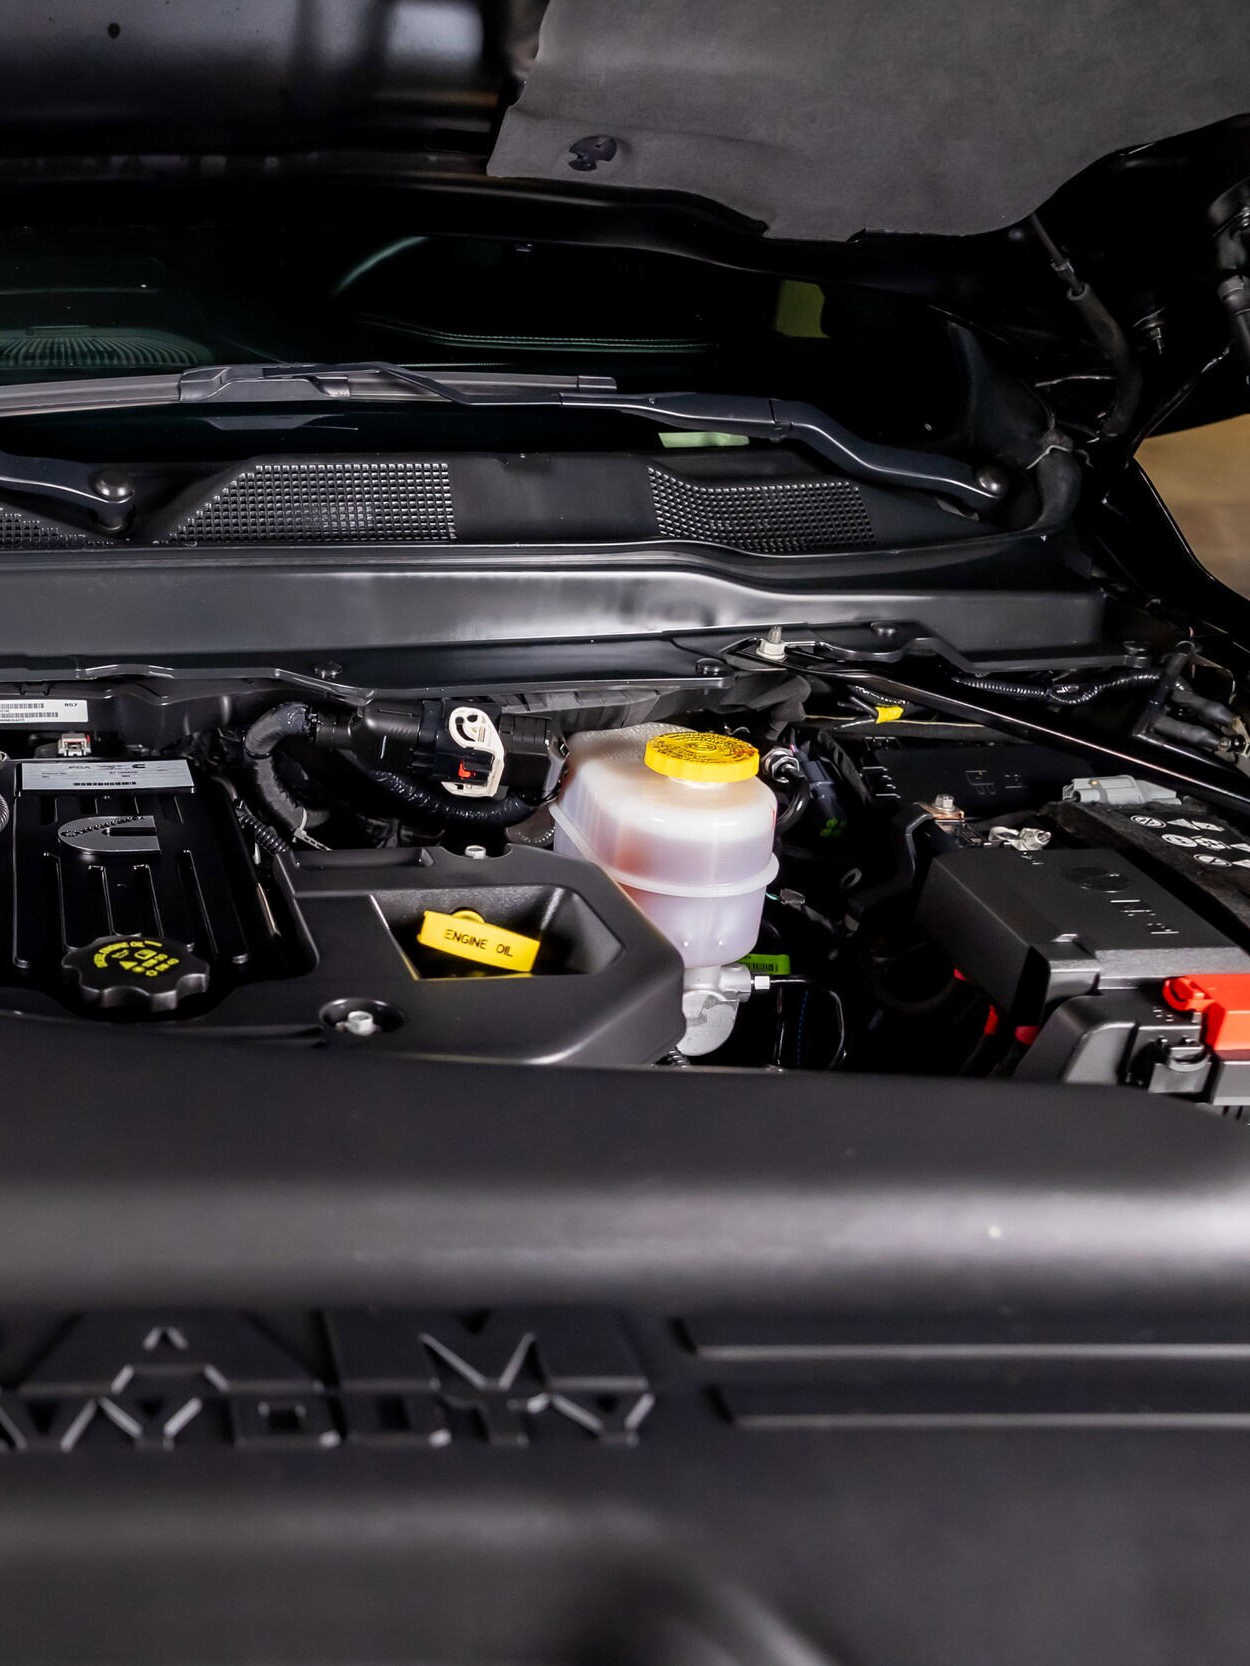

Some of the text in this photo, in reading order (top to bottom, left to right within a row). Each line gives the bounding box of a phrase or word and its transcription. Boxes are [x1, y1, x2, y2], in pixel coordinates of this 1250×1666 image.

[444, 929, 513, 957] ENGINE OIL
[230, 1394, 655, 1451] DUTY
